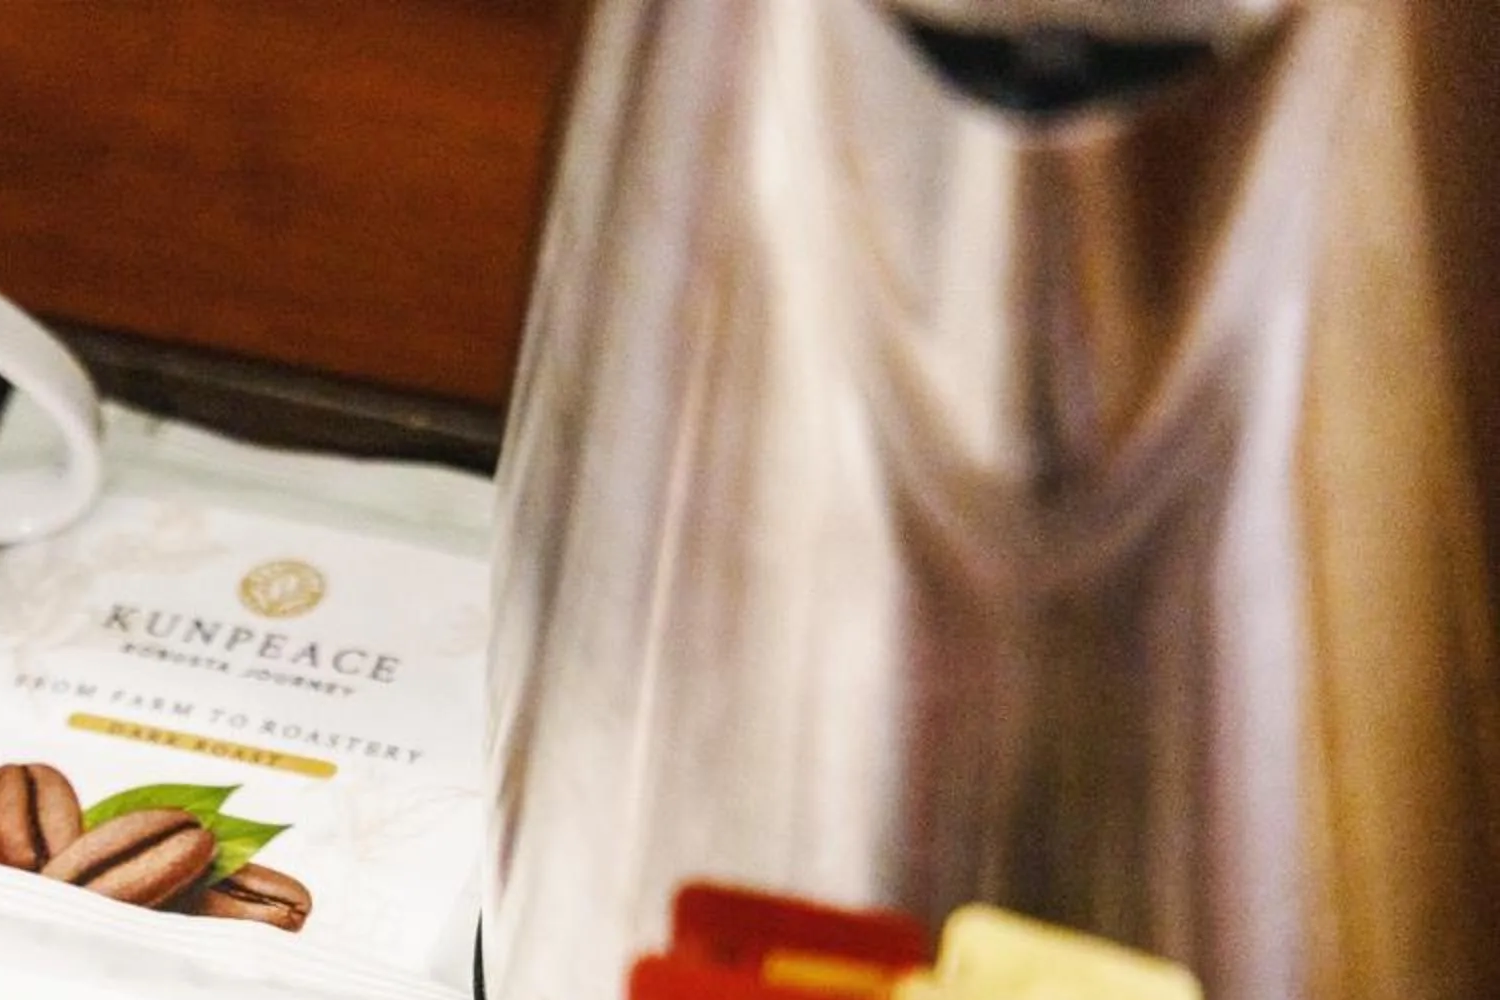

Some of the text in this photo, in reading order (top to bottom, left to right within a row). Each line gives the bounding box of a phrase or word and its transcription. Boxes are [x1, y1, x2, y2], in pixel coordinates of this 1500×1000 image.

[102, 604, 404, 684] KUNPEACE
[120, 640, 357, 698] ROBUSTA JOURNEY
[15, 672, 426, 765] FROM FARM TO ROASTERY
[105, 720, 283, 768] DARK ROAST
